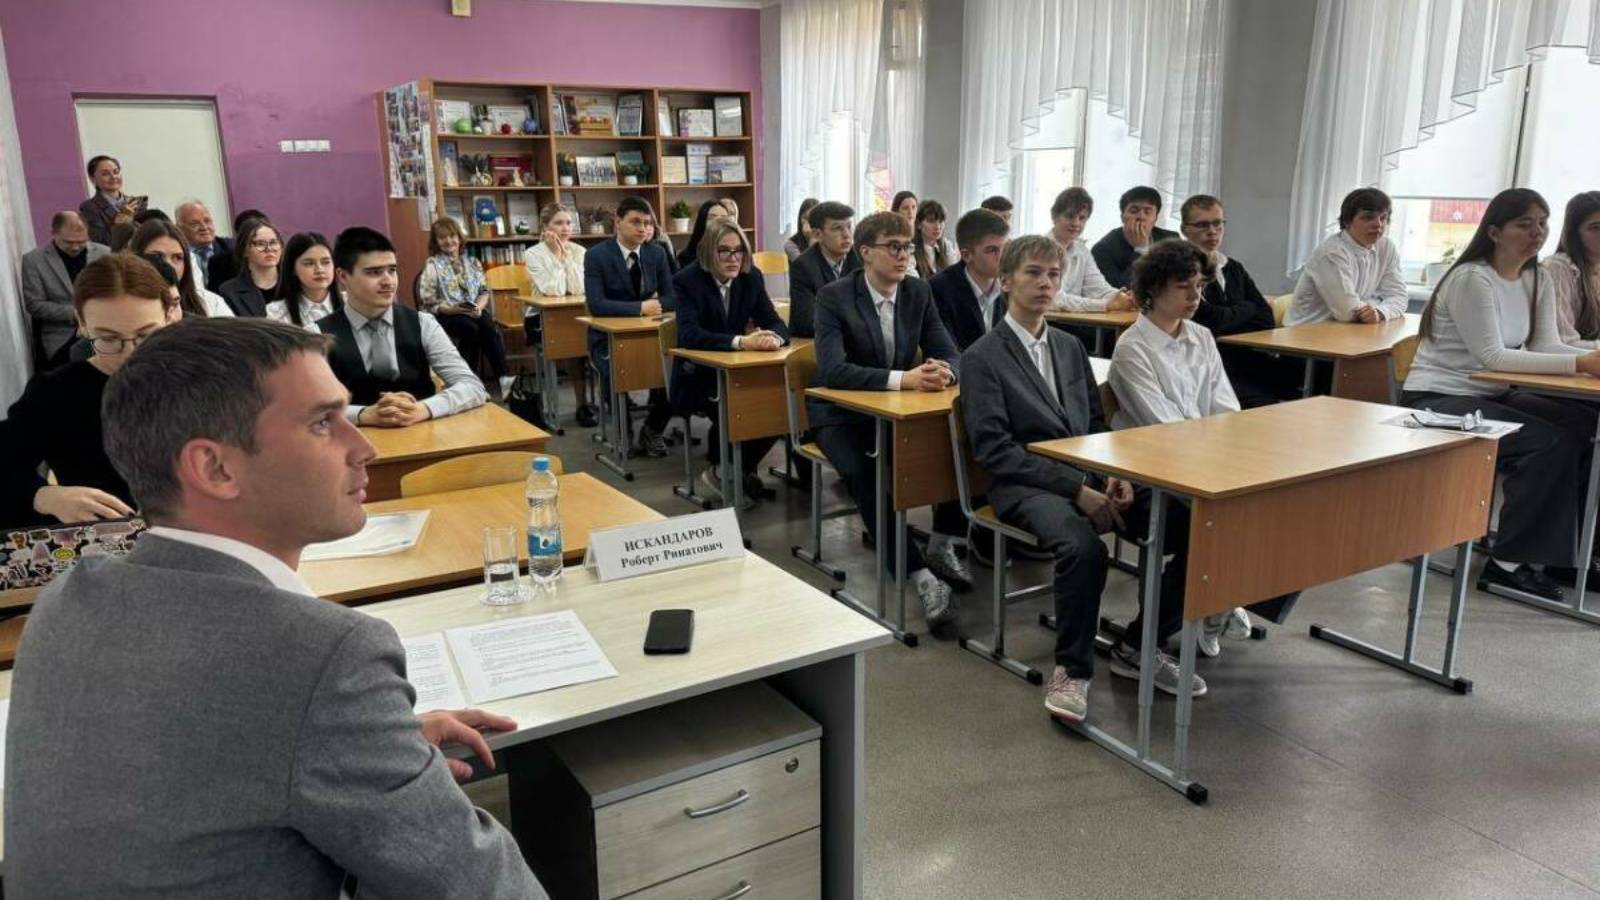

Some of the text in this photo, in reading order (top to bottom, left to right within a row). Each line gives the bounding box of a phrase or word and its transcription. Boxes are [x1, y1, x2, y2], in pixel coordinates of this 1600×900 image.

[624, 527, 713, 552] ИСКАНДАРОВ
[621, 541, 723, 568] Роберт Ринатович
